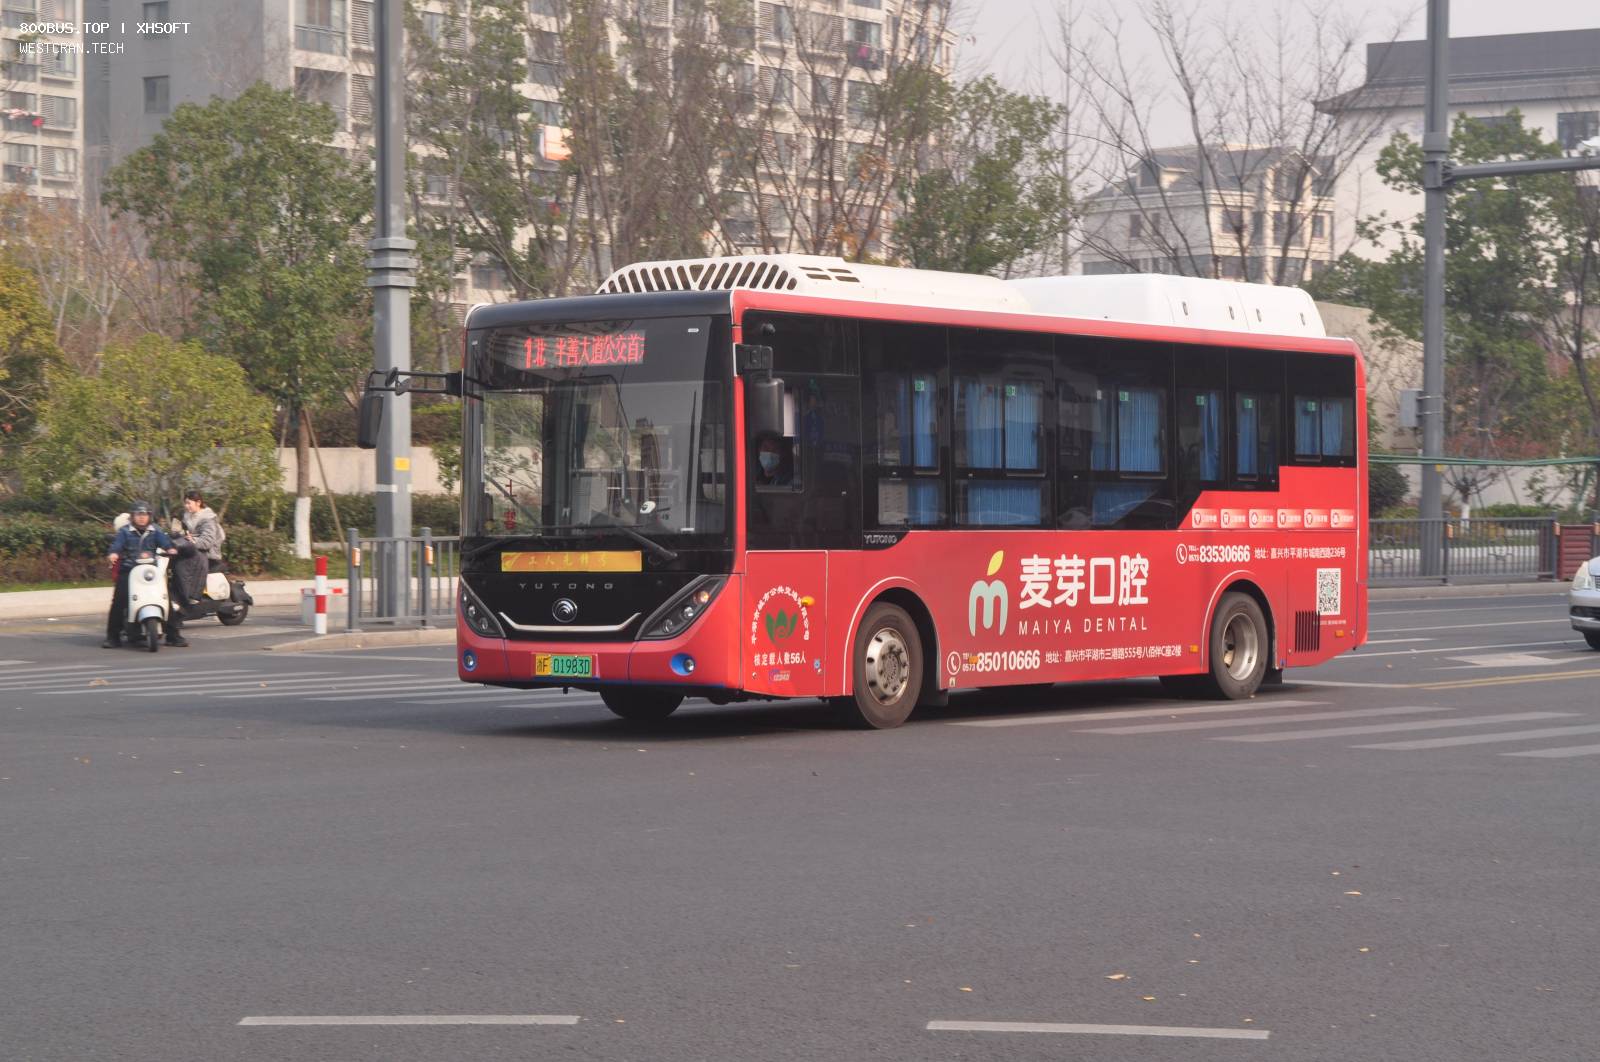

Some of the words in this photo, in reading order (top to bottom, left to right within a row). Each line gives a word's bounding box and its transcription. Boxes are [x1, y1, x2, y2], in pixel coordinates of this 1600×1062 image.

[863, 533, 898, 545] YUTONG
[1199, 544, 1251, 563] 83530666
[519, 582, 614, 590] YUTONG
[1019, 553, 1149, 609] 麦芽口腔
[1018, 619, 1072, 636] MAIYA
[1083, 616, 1148, 633] DENTAL
[976, 649, 1041, 673] 85010666
